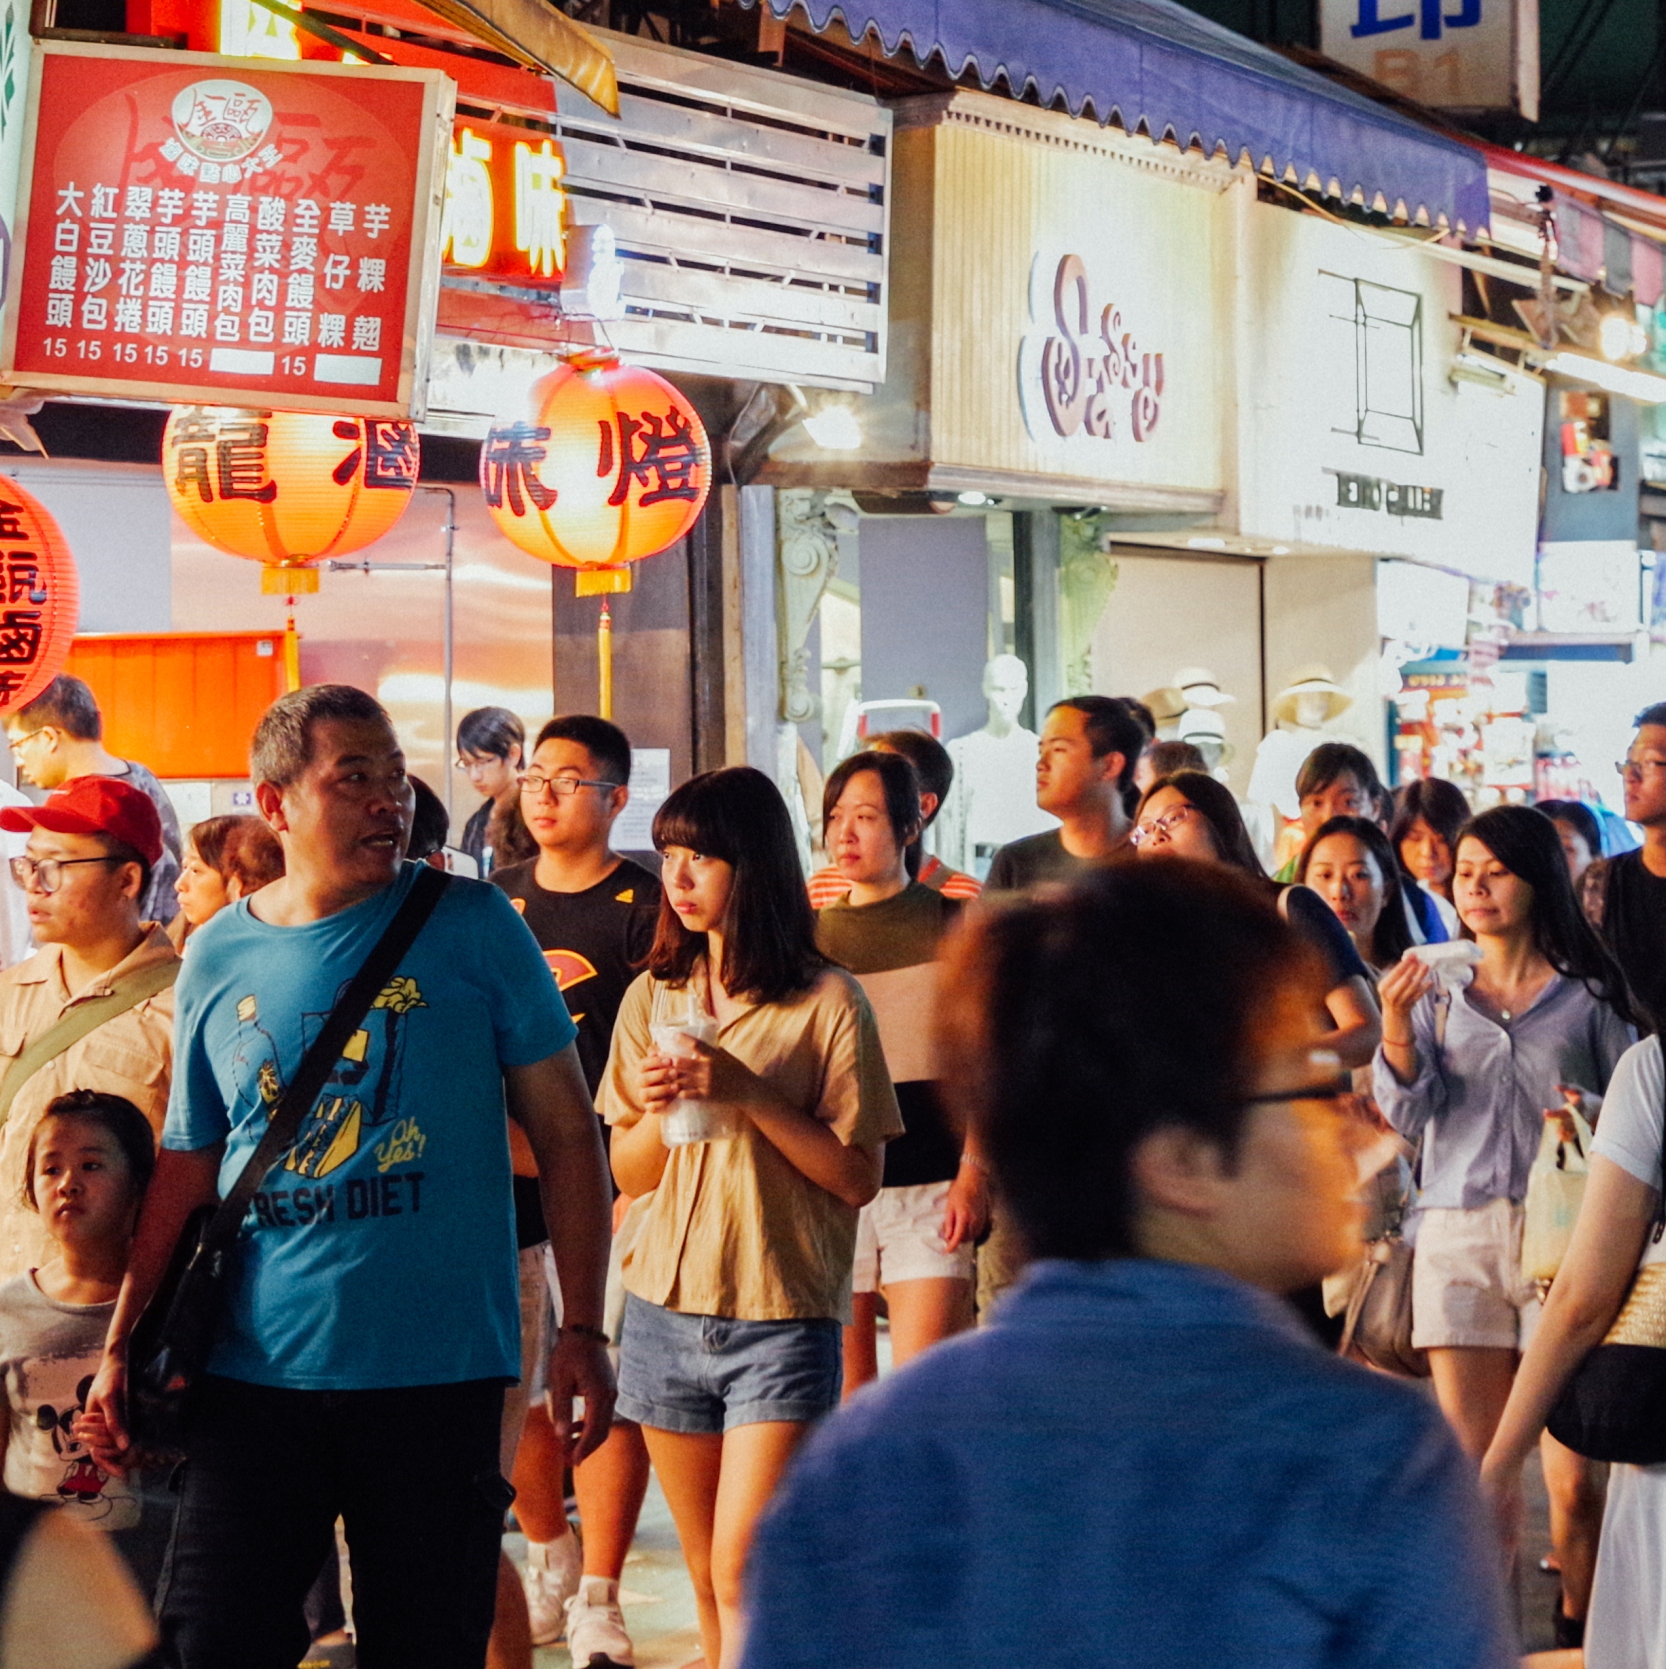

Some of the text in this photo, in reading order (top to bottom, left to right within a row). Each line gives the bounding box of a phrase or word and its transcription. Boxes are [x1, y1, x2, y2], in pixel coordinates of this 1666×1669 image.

[159, 137, 283, 184] 滷味點心大王
[45, 181, 85, 328] 大白饅頭
[81, 182, 119, 330] 紅豆沙包
[146, 188, 185, 337] 芋頭饅頭
[179, 190, 220, 339] 芋頭饅頭
[214, 193, 254, 343] 高麗菜肉包
[247, 195, 287, 343] 酸菜肉包
[282, 198, 321, 346] 全麥饅頭
[318, 201, 357, 348] 草仔粿
[43, 336, 307, 376] 15 15 15 15 15 15
[346, 1172, 424, 1220] DIET
